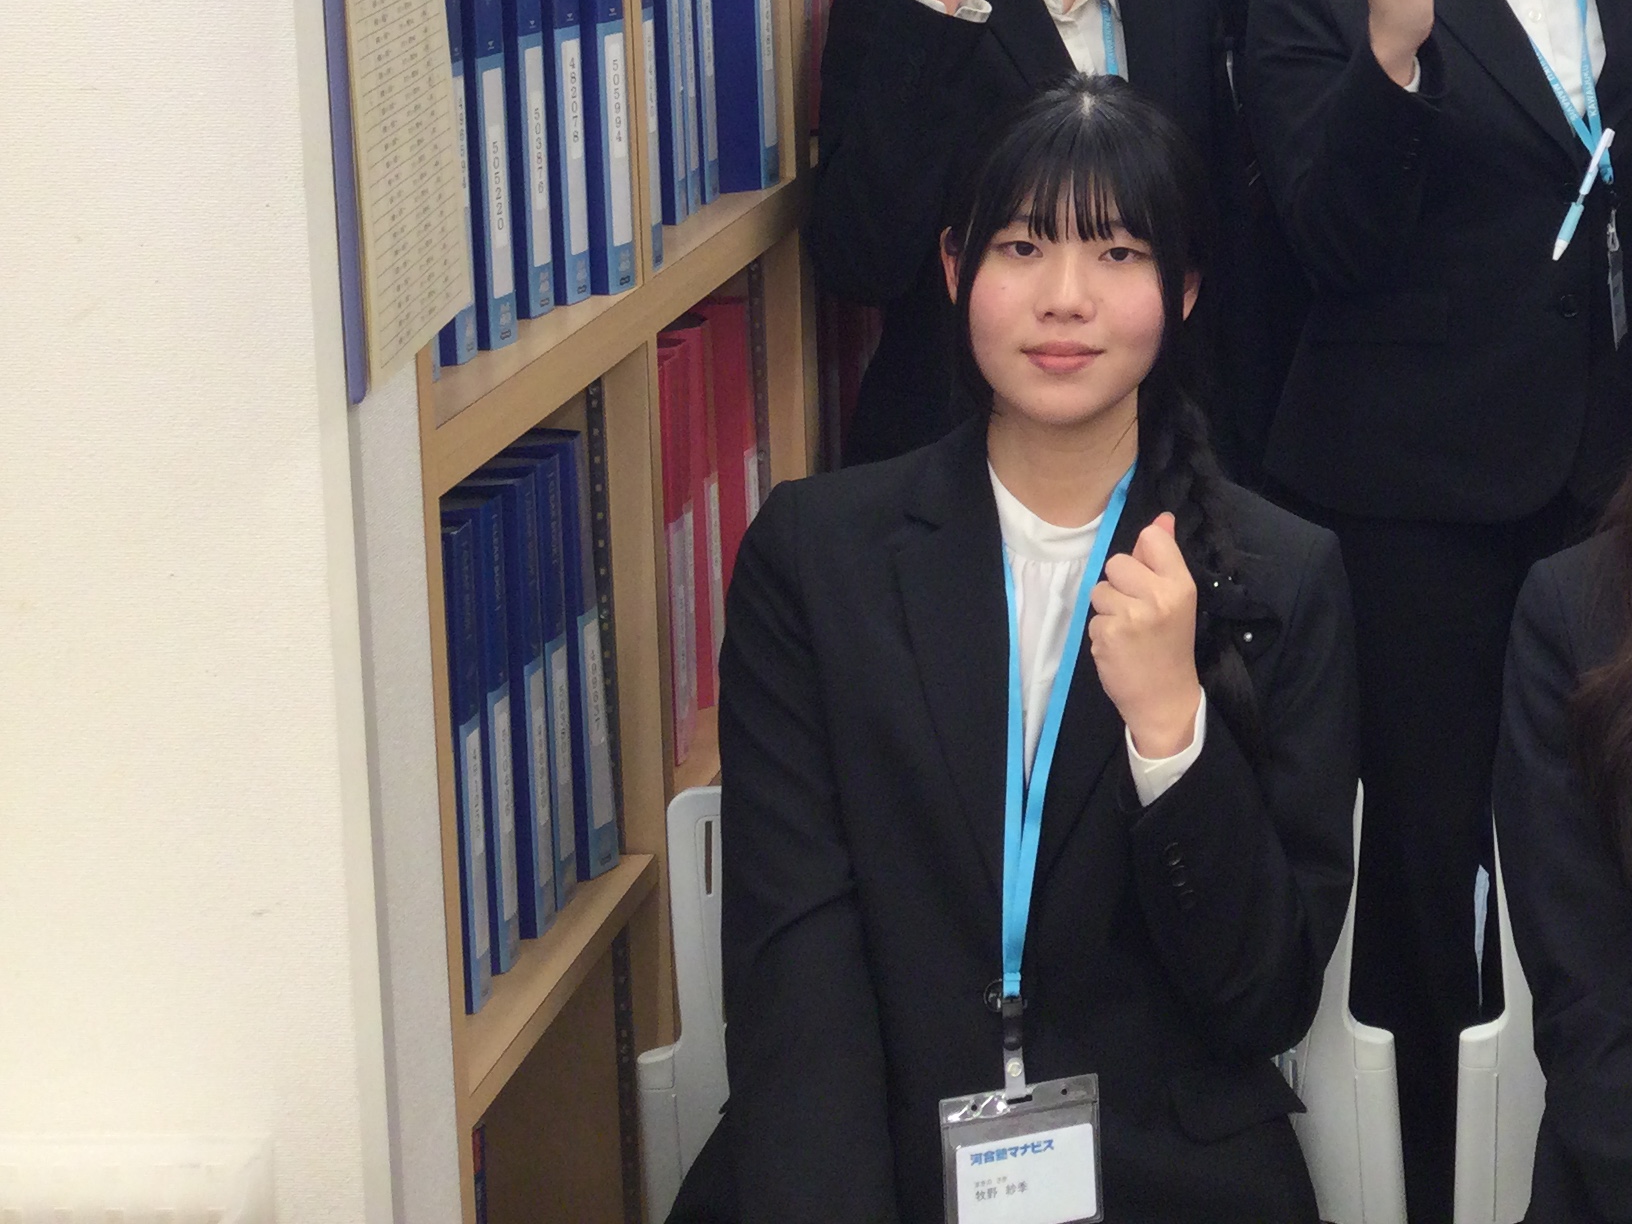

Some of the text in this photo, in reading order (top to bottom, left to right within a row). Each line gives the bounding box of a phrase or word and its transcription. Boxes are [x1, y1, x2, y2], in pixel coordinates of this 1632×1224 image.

[1553, 82, 1580, 123] MANAVIS
[492, 141, 505, 231] 505220
[970, 1139, 1055, 1166] 河合塾マナビス
